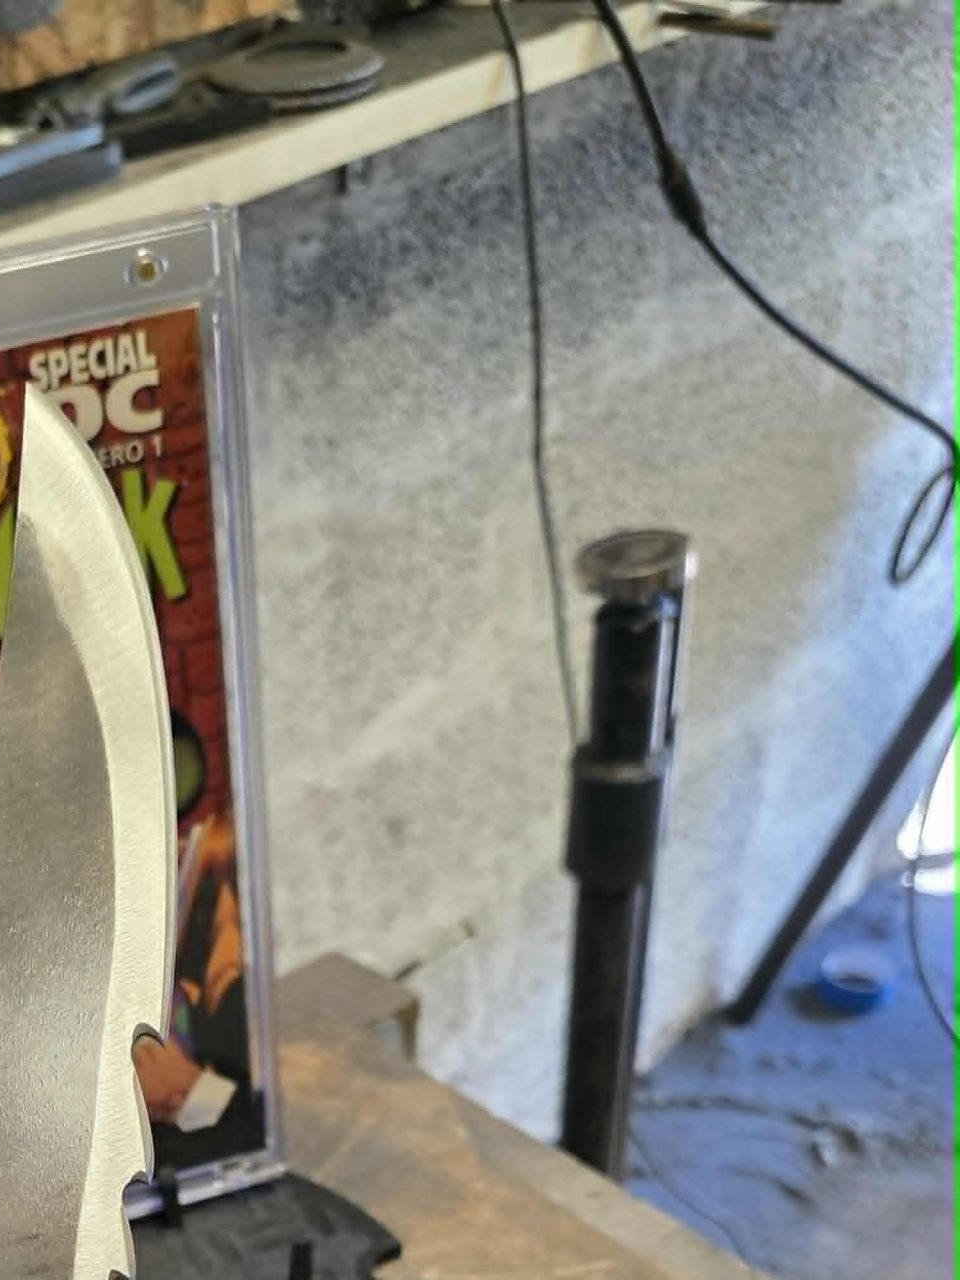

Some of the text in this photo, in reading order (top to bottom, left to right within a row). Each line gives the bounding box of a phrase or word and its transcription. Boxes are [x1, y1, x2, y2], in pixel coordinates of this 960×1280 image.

[28, 331, 157, 392] SPECIAL
[41, 369, 166, 443] DC
[151, 434, 163, 458] 1
